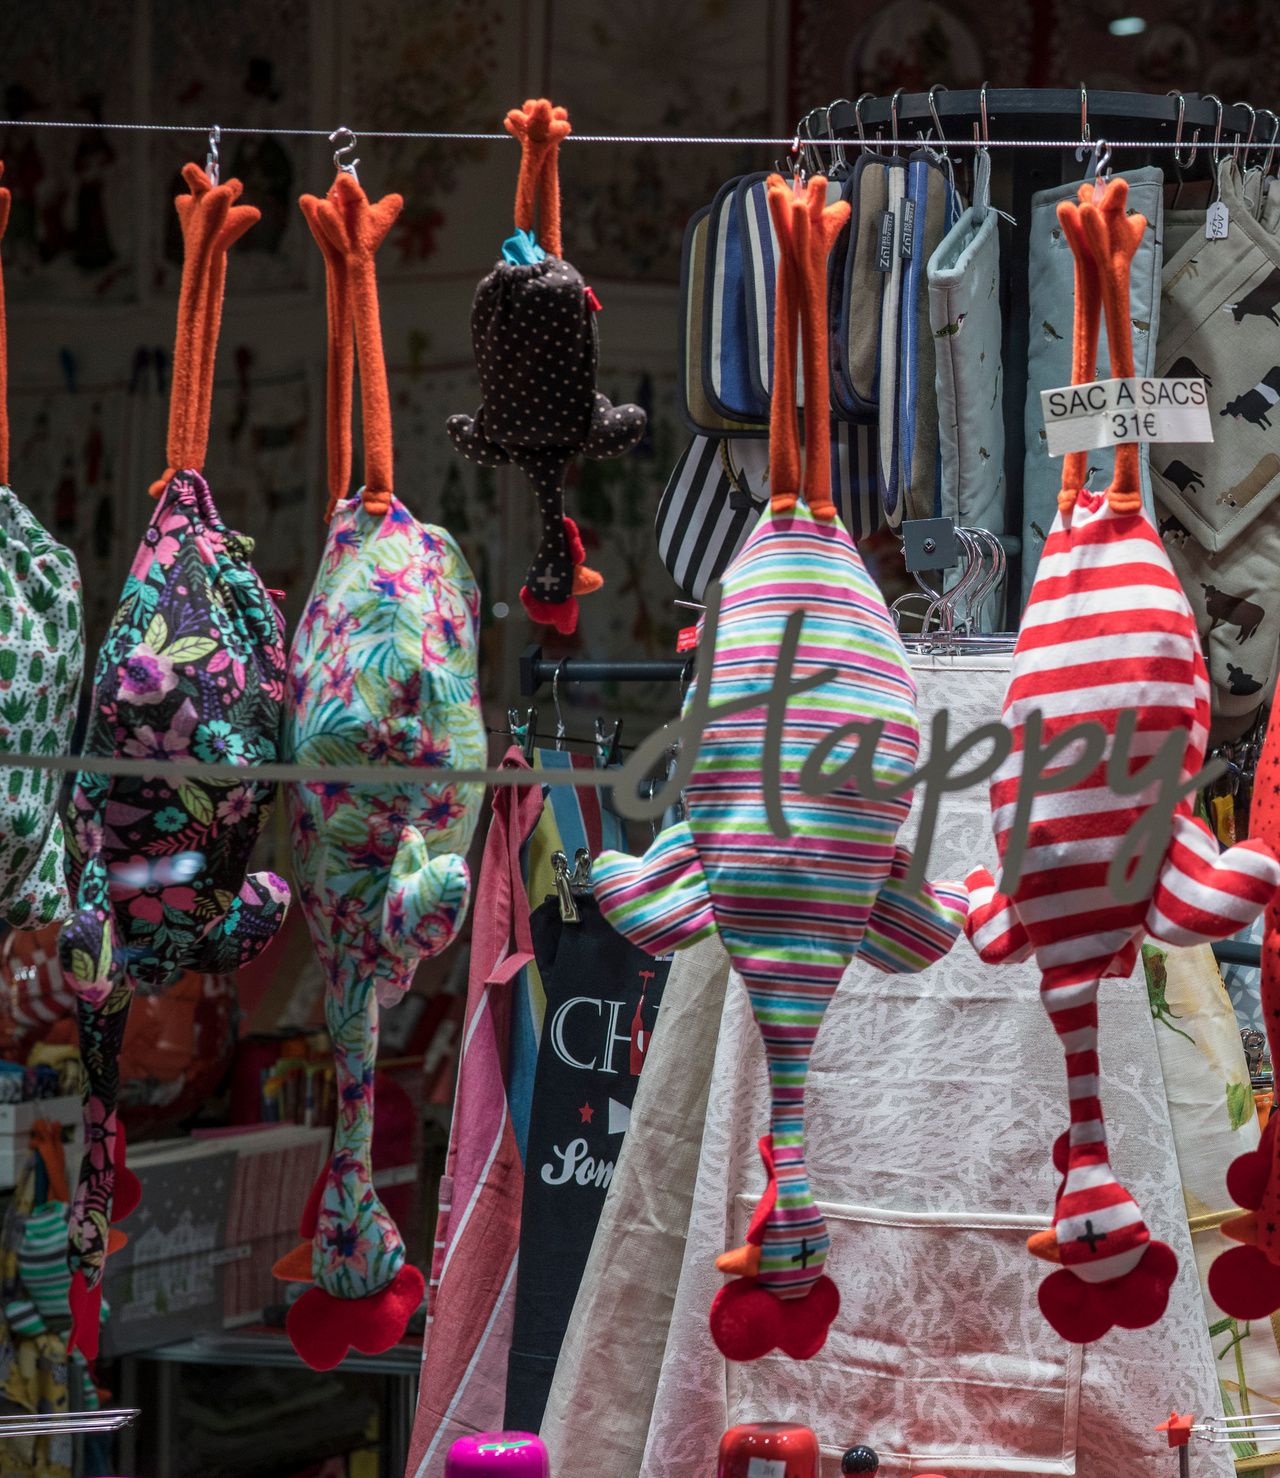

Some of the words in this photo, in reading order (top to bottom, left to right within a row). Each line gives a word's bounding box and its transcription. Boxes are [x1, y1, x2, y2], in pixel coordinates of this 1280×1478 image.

[1049, 386, 1107, 417] SAC
[1116, 382, 1135, 406] A
[1141, 381, 1206, 405] SACS
[1112, 413, 1157, 438] 31€
[612, 580, 1227, 902] Happy
